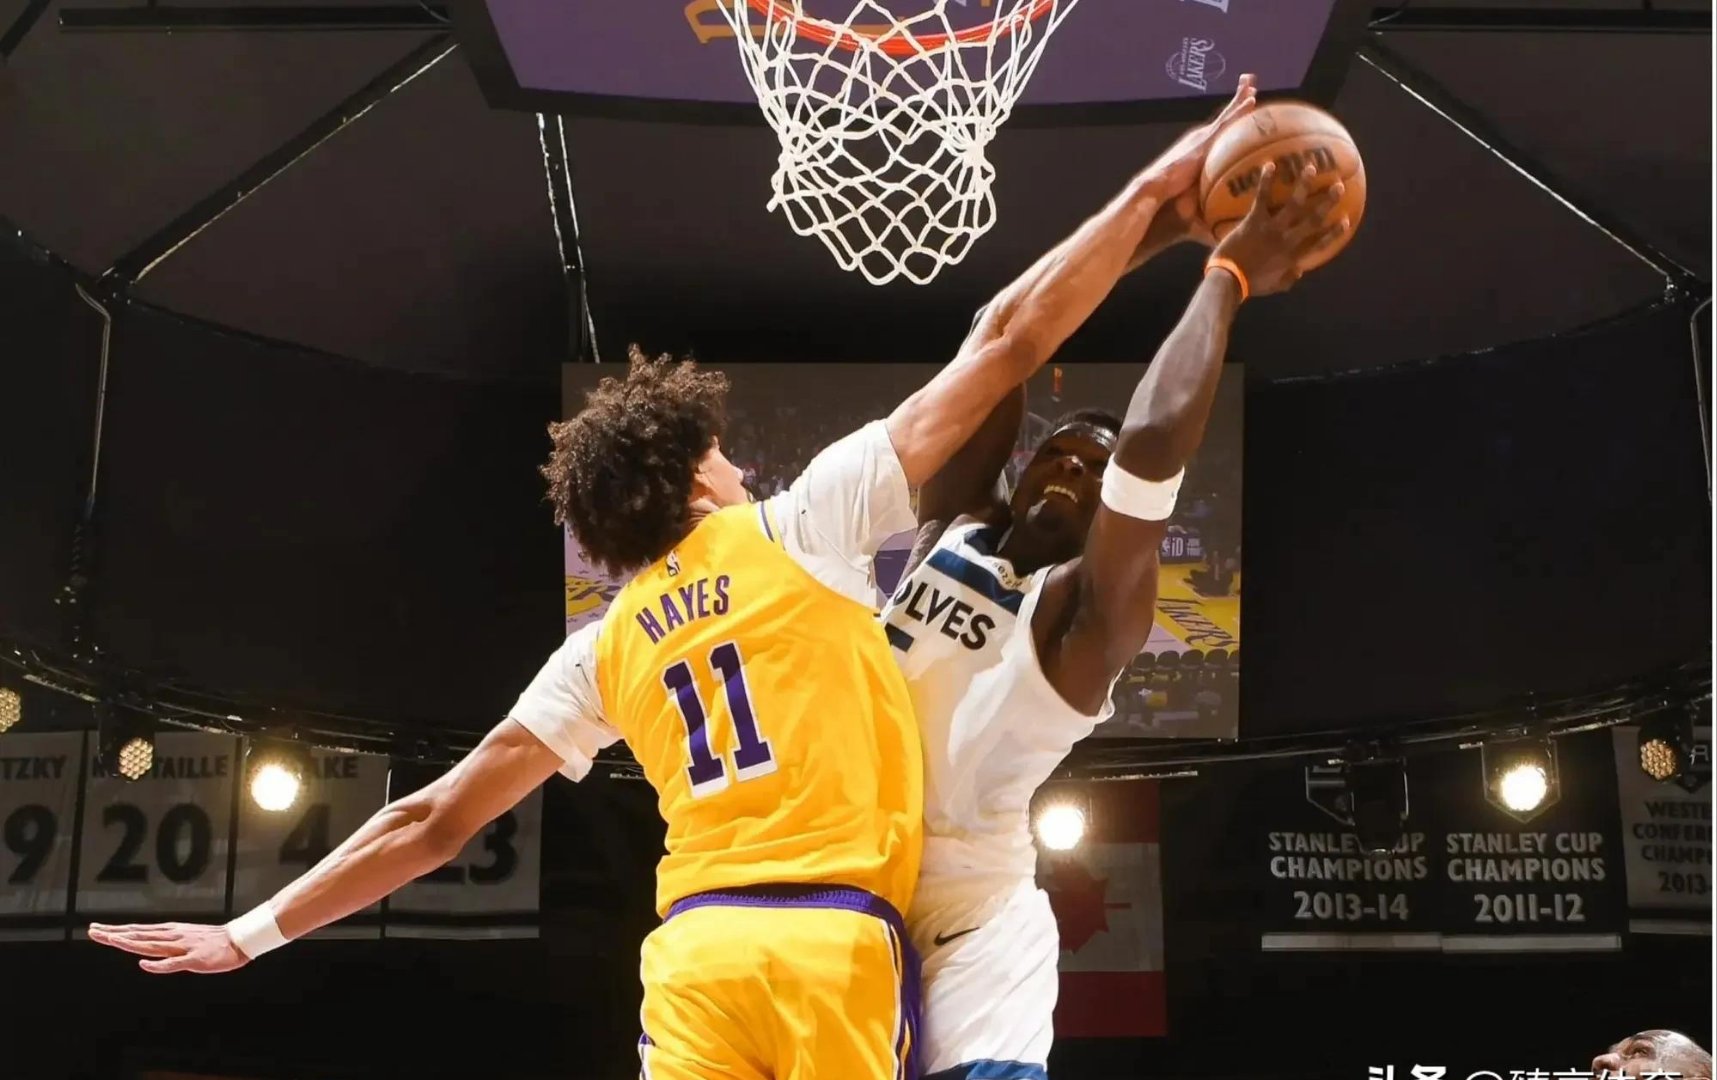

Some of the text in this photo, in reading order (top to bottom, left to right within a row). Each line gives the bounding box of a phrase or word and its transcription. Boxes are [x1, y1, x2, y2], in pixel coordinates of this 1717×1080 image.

[1179, 38, 1215, 93] LAKERS
[636, 575, 730, 645] HAYES
[661, 640, 778, 798] 11
[92, 755, 229, 780] RTAILLE
[96, 802, 212, 884] 20
[280, 802, 334, 872] 4
[412, 810, 518, 886] 3
[1268, 831, 1425, 853] STANLE UP
[1446, 832, 1604, 854] STANLEY CUP
[1270, 855, 1428, 881] CHAMPIONS
[1447, 857, 1607, 882] CHAMPIONS
[1659, 871, 1713, 895] 2013
[1293, 890, 1409, 921] 2013-14
[1474, 893, 1585, 922] 2011-12
